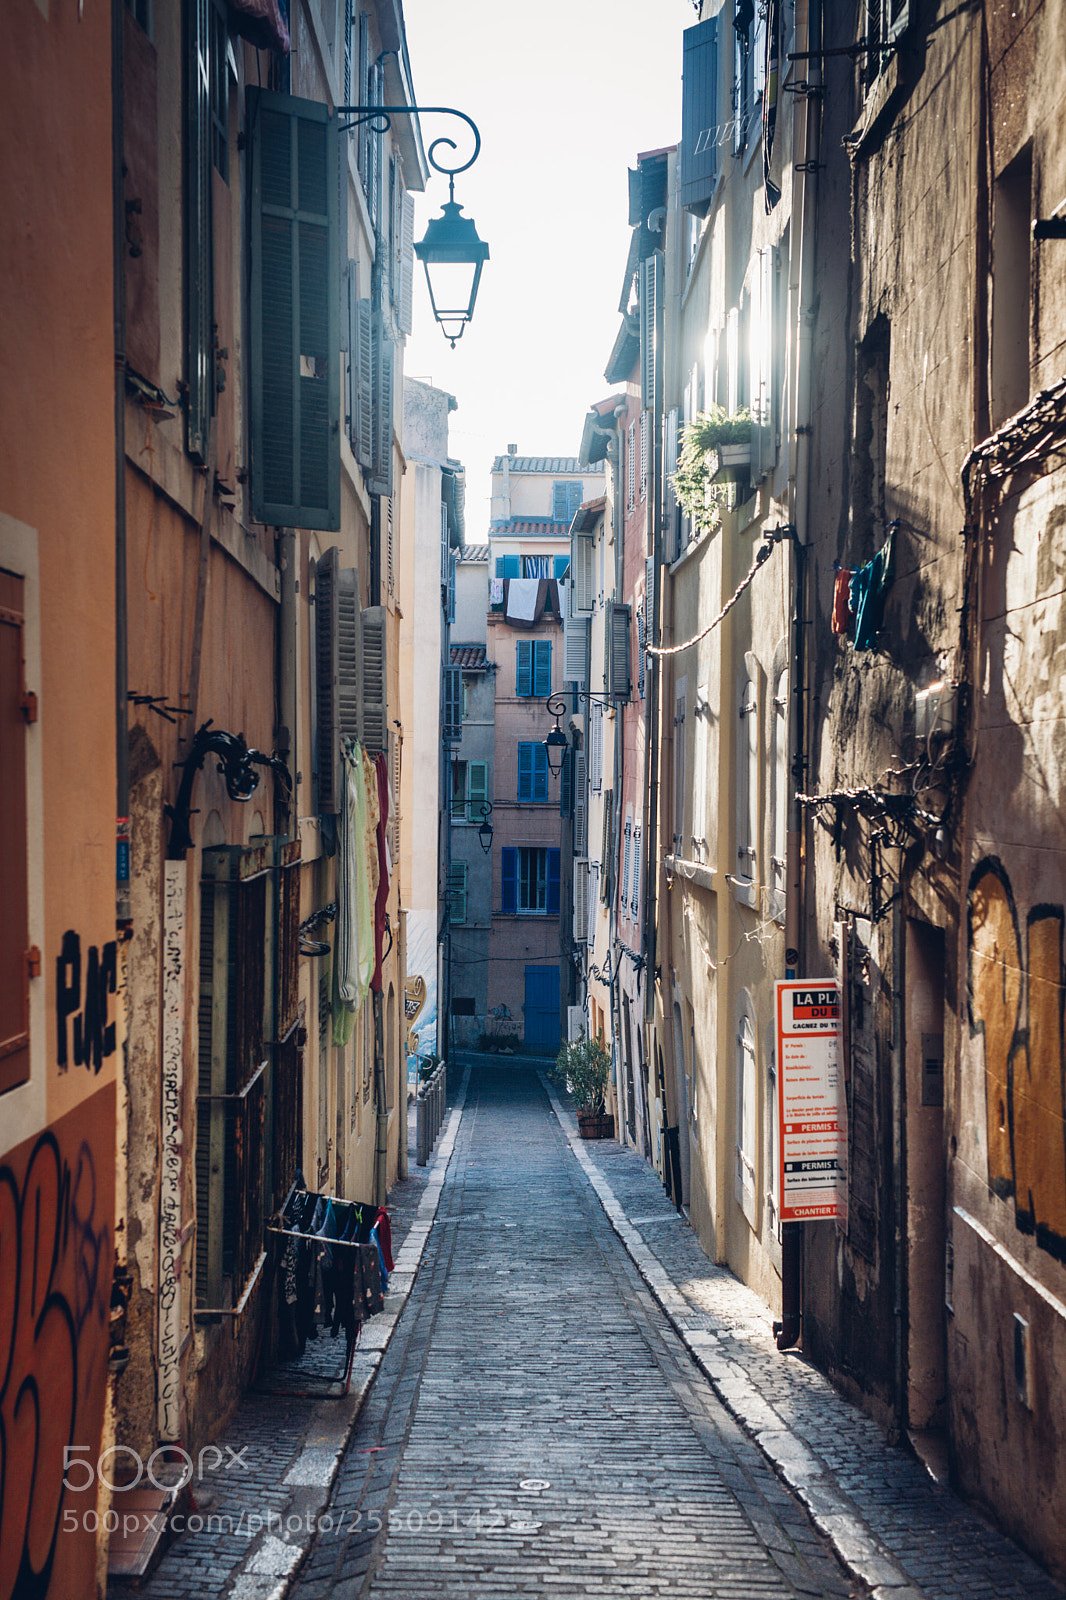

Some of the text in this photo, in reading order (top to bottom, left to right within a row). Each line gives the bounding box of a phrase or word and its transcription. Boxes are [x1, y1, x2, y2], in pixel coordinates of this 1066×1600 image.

[796, 993, 814, 1005] LA
[811, 1007, 828, 1017] DU
[801, 1123, 832, 1131] PERMIS
[801, 1161, 832, 1170] PERMIS
[794, 1207, 831, 1216] CHANTIER
